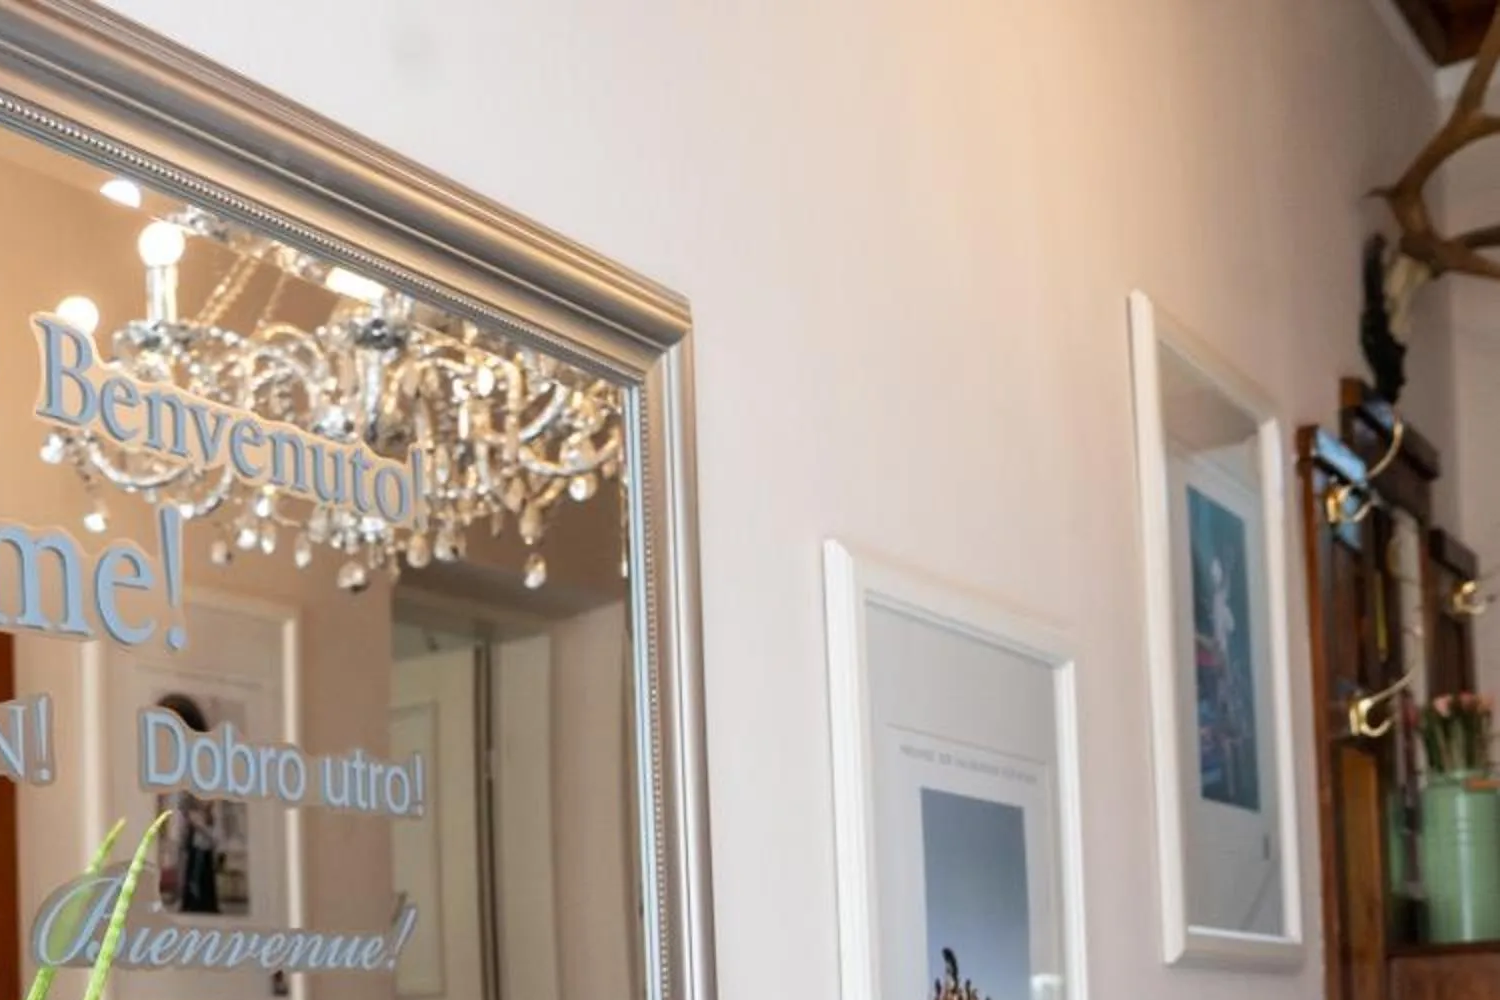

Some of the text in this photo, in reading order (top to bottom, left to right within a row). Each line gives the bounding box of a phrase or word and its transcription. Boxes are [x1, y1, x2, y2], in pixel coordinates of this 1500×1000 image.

[34, 317, 428, 534] Benvenuto!
[143, 710, 424, 817] Dobro utro!
[38, 868, 417, 970] Bienvenue!
